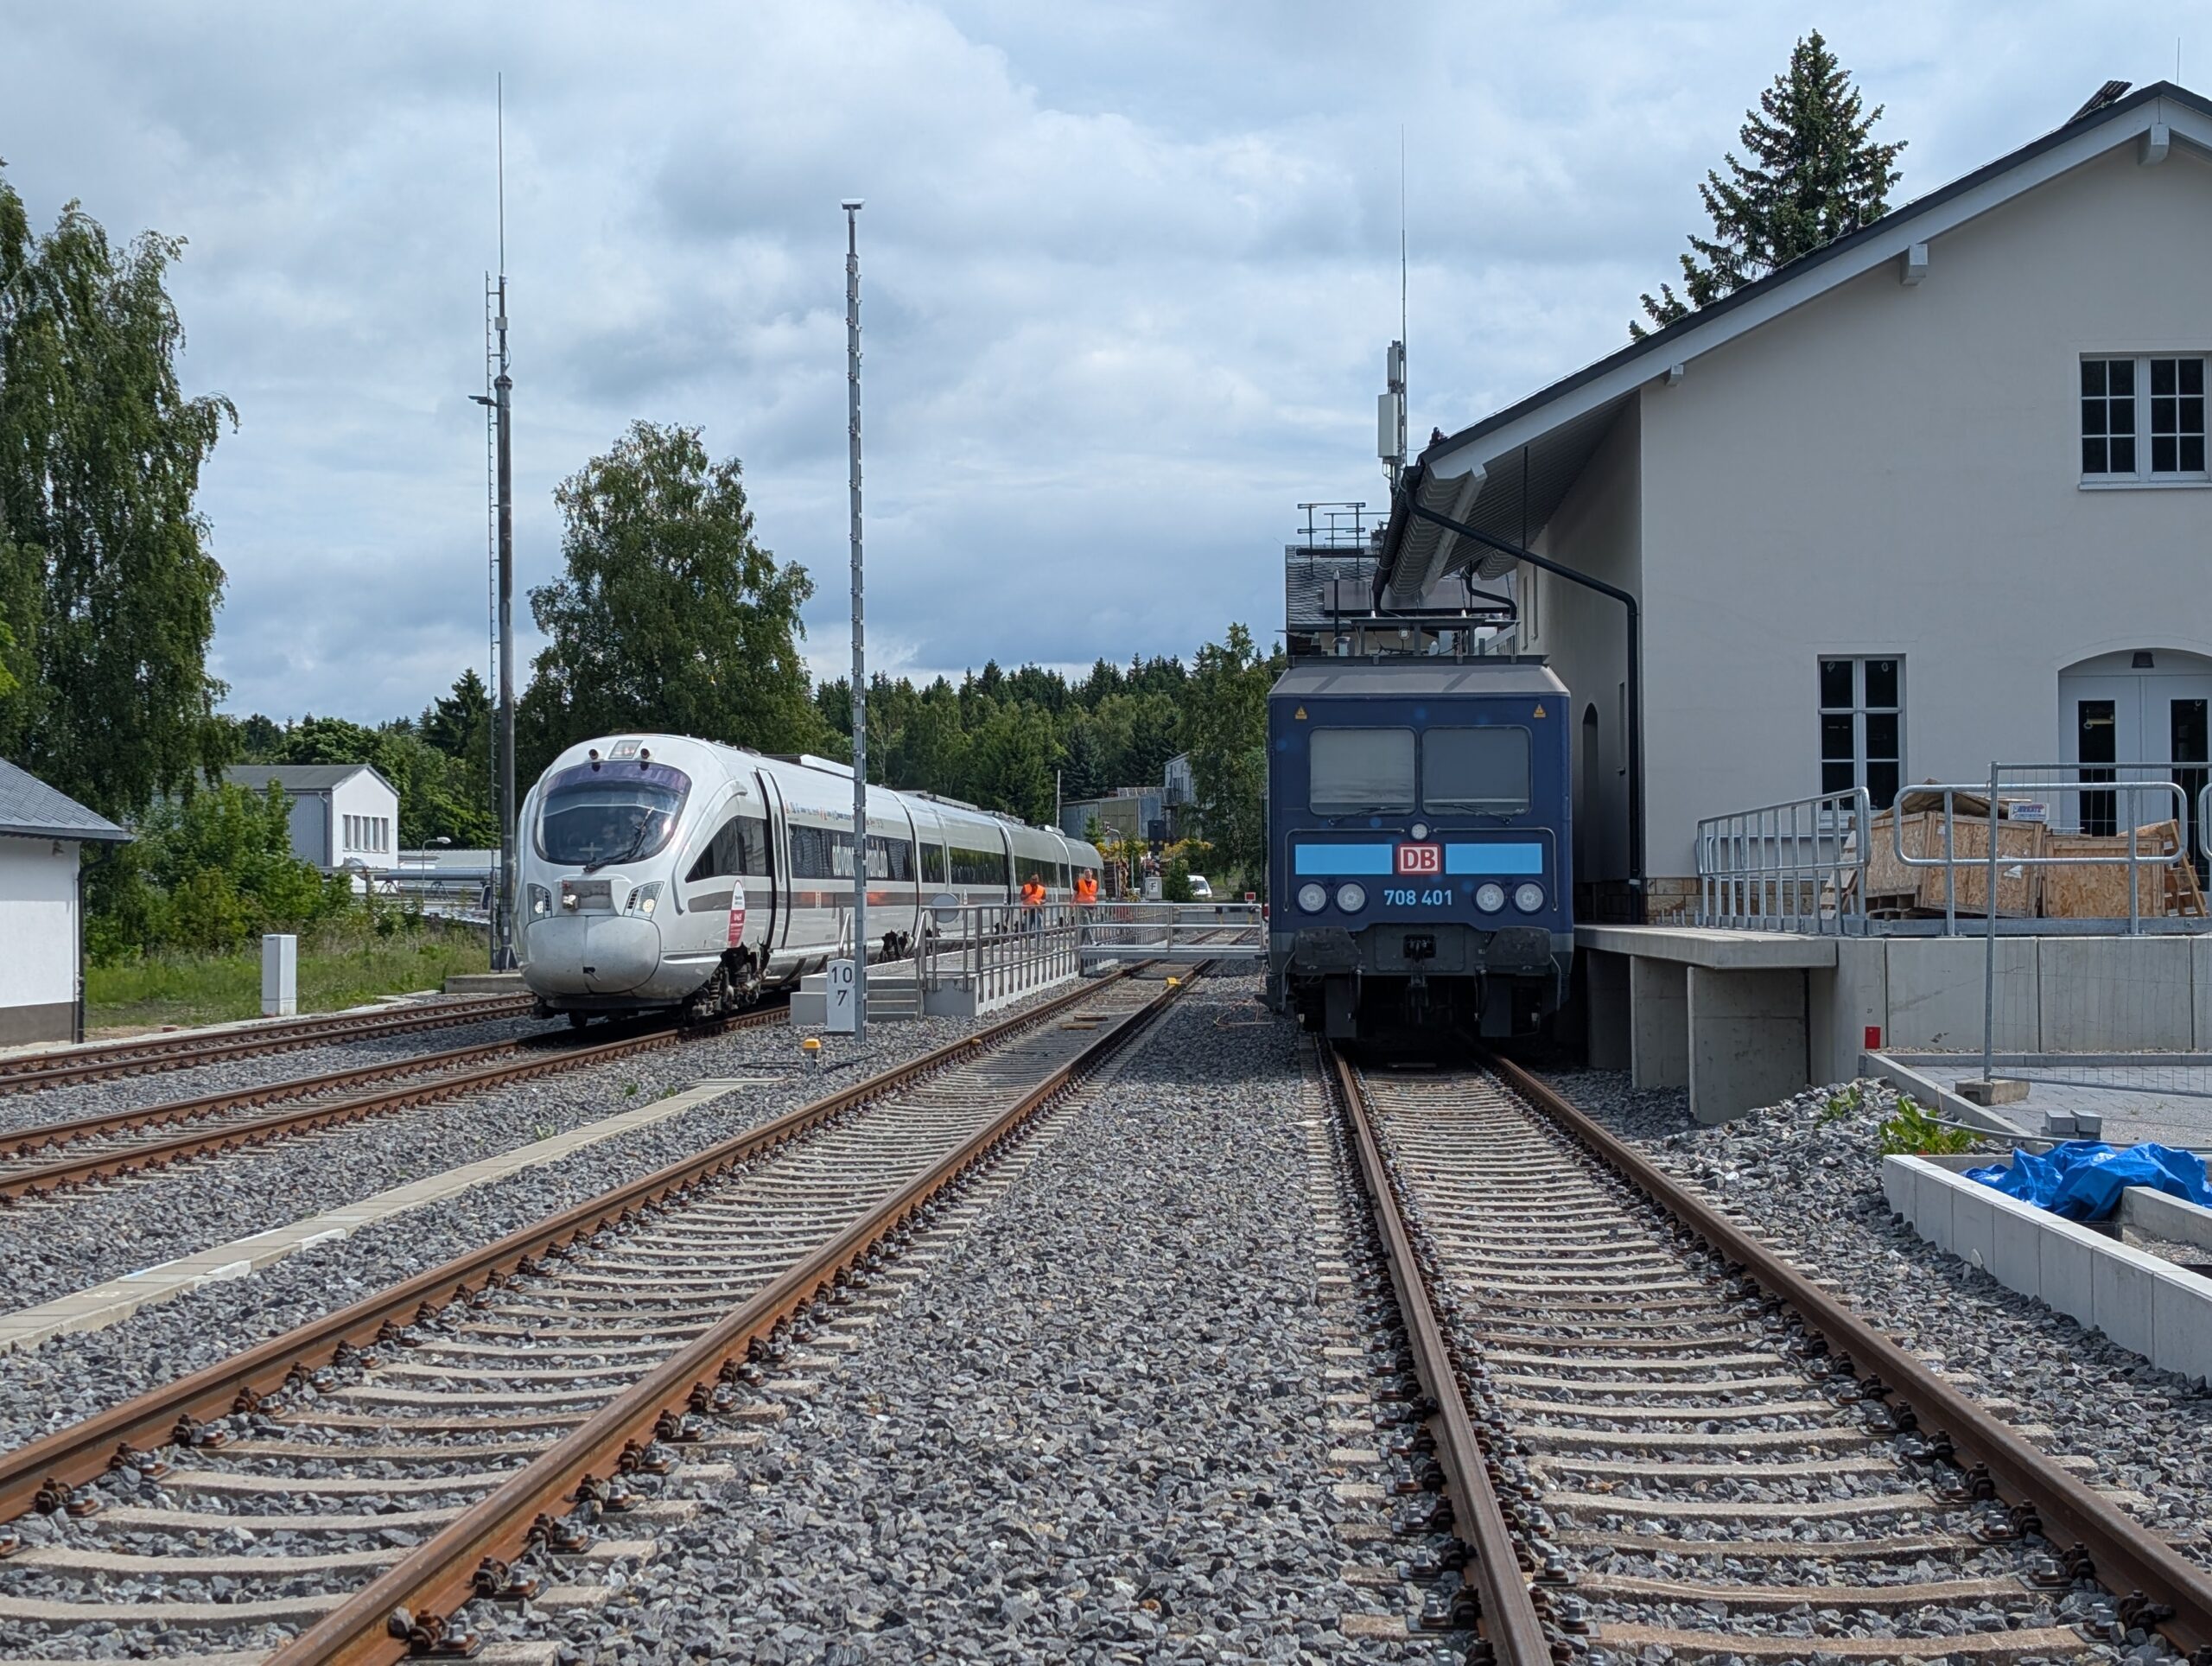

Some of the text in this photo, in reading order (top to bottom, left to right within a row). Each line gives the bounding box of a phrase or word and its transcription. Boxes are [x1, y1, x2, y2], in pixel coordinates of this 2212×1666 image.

[1402, 849, 1436, 869] DB
[1384, 889, 1452, 906] 708 401
[831, 966, 852, 983] 10
[837, 989, 848, 1007] 7
